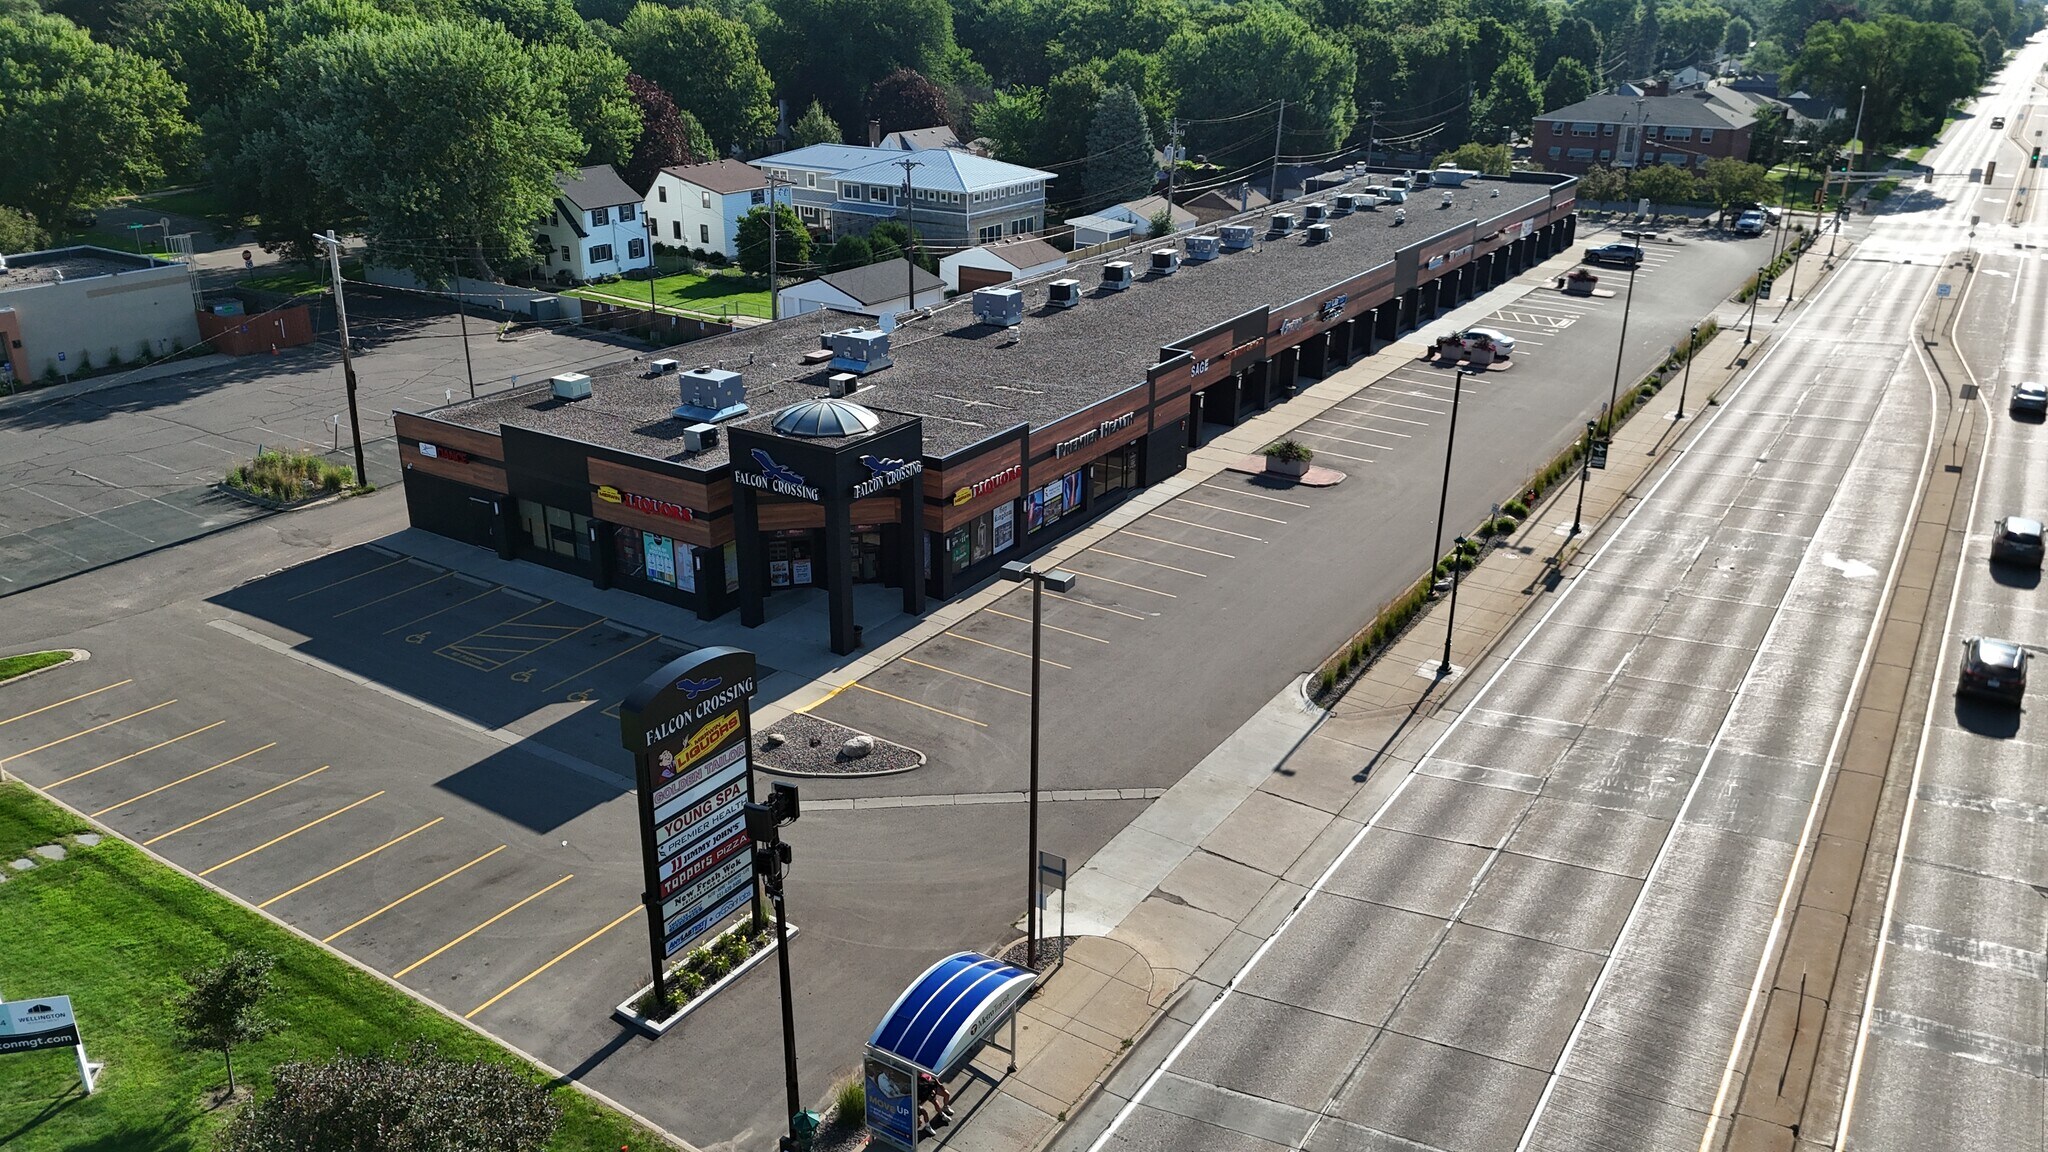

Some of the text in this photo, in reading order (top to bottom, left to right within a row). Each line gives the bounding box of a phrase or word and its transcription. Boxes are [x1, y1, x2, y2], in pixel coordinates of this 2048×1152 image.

[1190, 358, 1210, 378] SAGE
[1056, 411, 1135, 460] PREMIER HEALTH
[734, 470, 820, 501] FALCON CROSSING
[854, 460, 924, 499] FALCON CROSSING
[972, 464, 1022, 498] LIQUORS
[625, 493, 693, 522] LIQUORS
[645, 677, 754, 747] FALCON CROSSING
[677, 716, 738, 767] LIQUORS
[694, 722, 722, 746] MERWIN
[655, 744, 745, 804] GOLDEN TAILOR
[664, 783, 740, 837] YOUNG SPA
[668, 798, 747, 852] PREMIER HEALTH
[684, 842, 711, 863] JIMMY
[713, 822, 739, 845] JOHN'S
[716, 834, 747, 859] PIZZA
[675, 857, 741, 906] New Fresh Wok
[18, 1012, 66, 1023] WELLINGTON
[870, 1096, 910, 1116] MOVE UP
